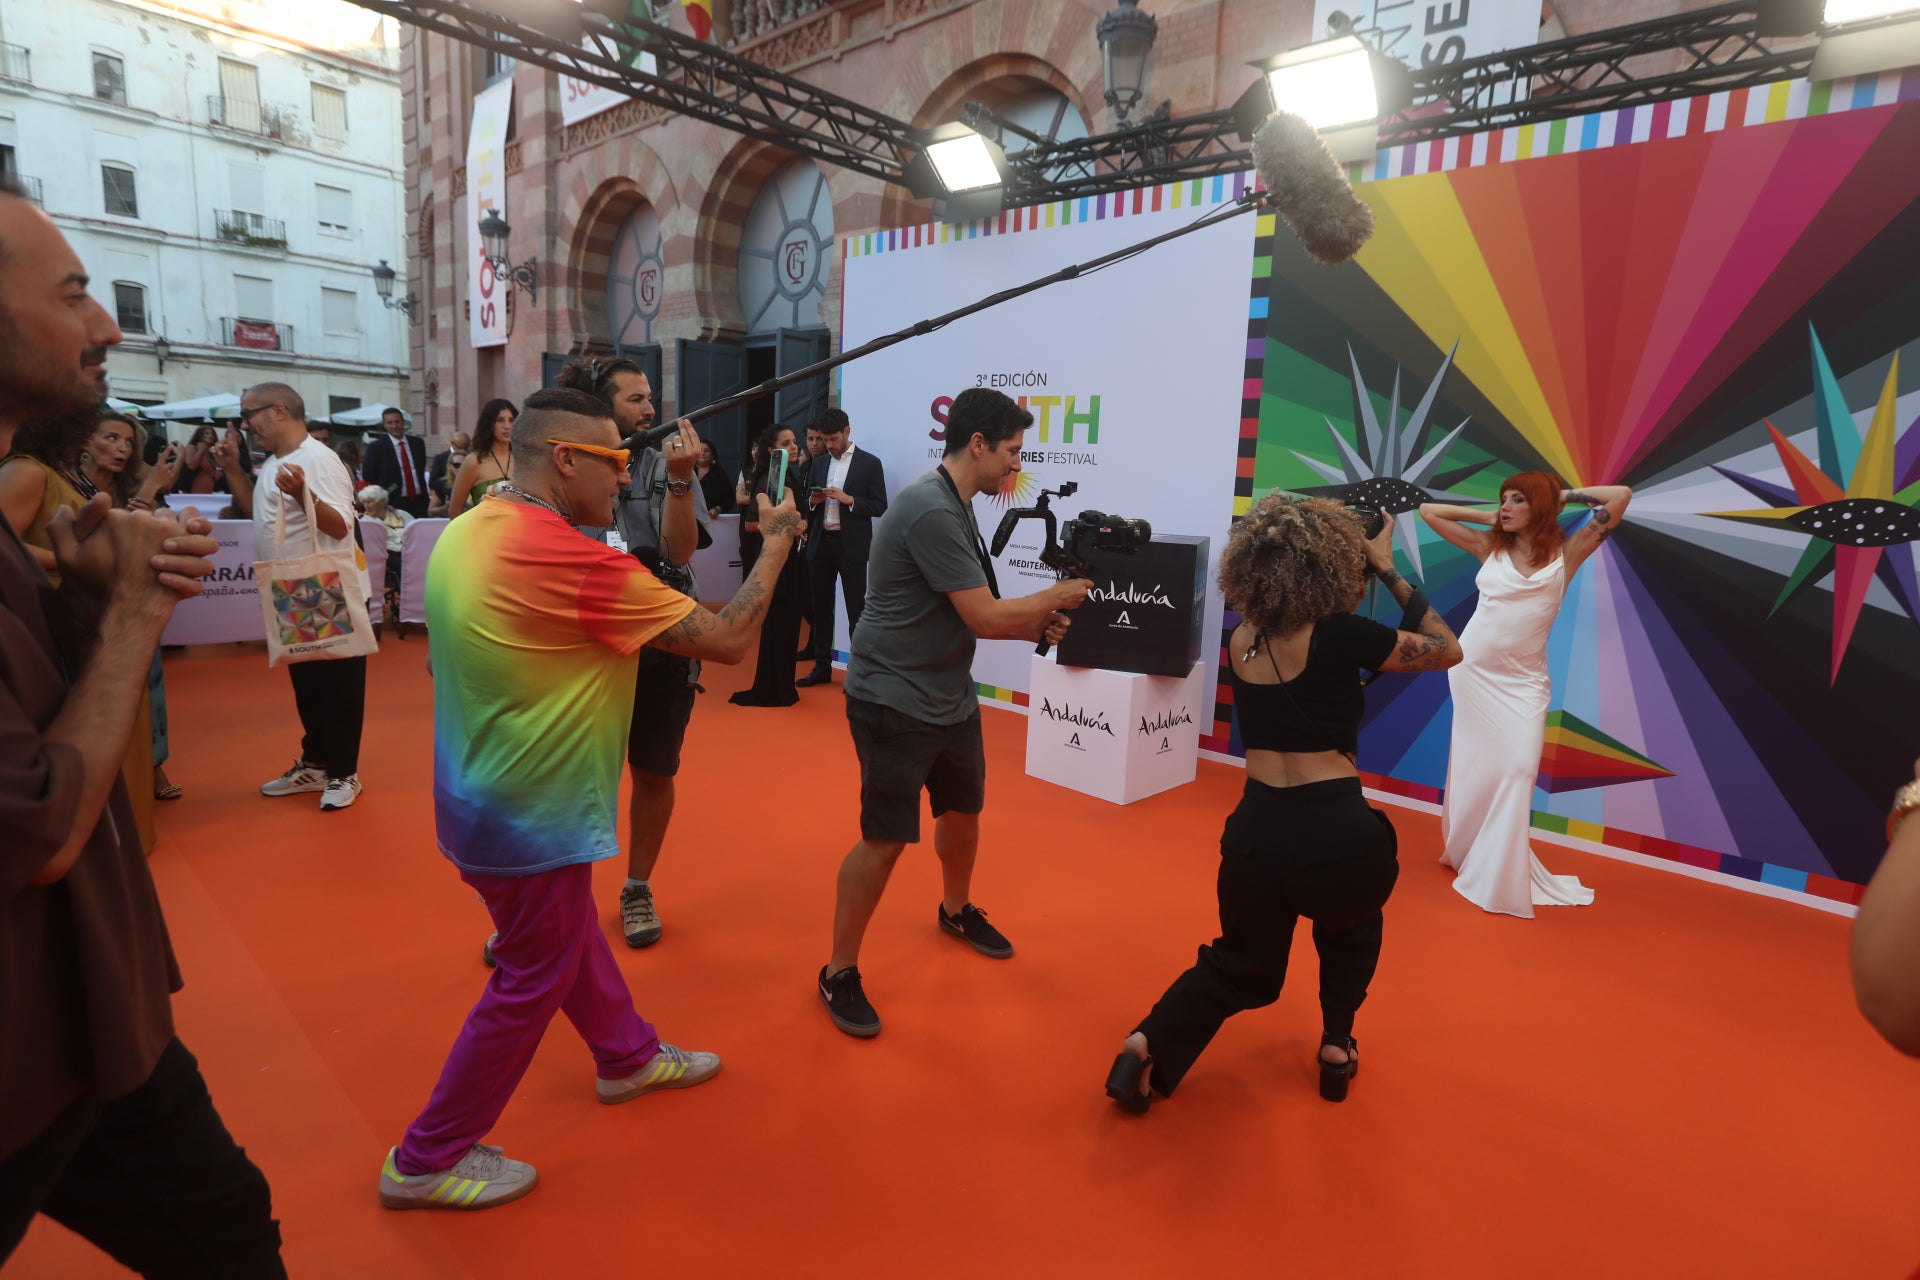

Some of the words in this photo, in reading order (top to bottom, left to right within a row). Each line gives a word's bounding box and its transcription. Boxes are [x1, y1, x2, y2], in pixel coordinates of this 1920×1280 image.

[478, 151, 497, 329] SOTH
[991, 370, 1047, 387] EDICIÓN
[929, 395, 1100, 444] STH
[1020, 451, 1045, 463] RIES
[1047, 452, 1098, 466] FESTIVAL
[1040, 696, 1116, 737] Andalucía
[1138, 706, 1193, 737] Andalucía
